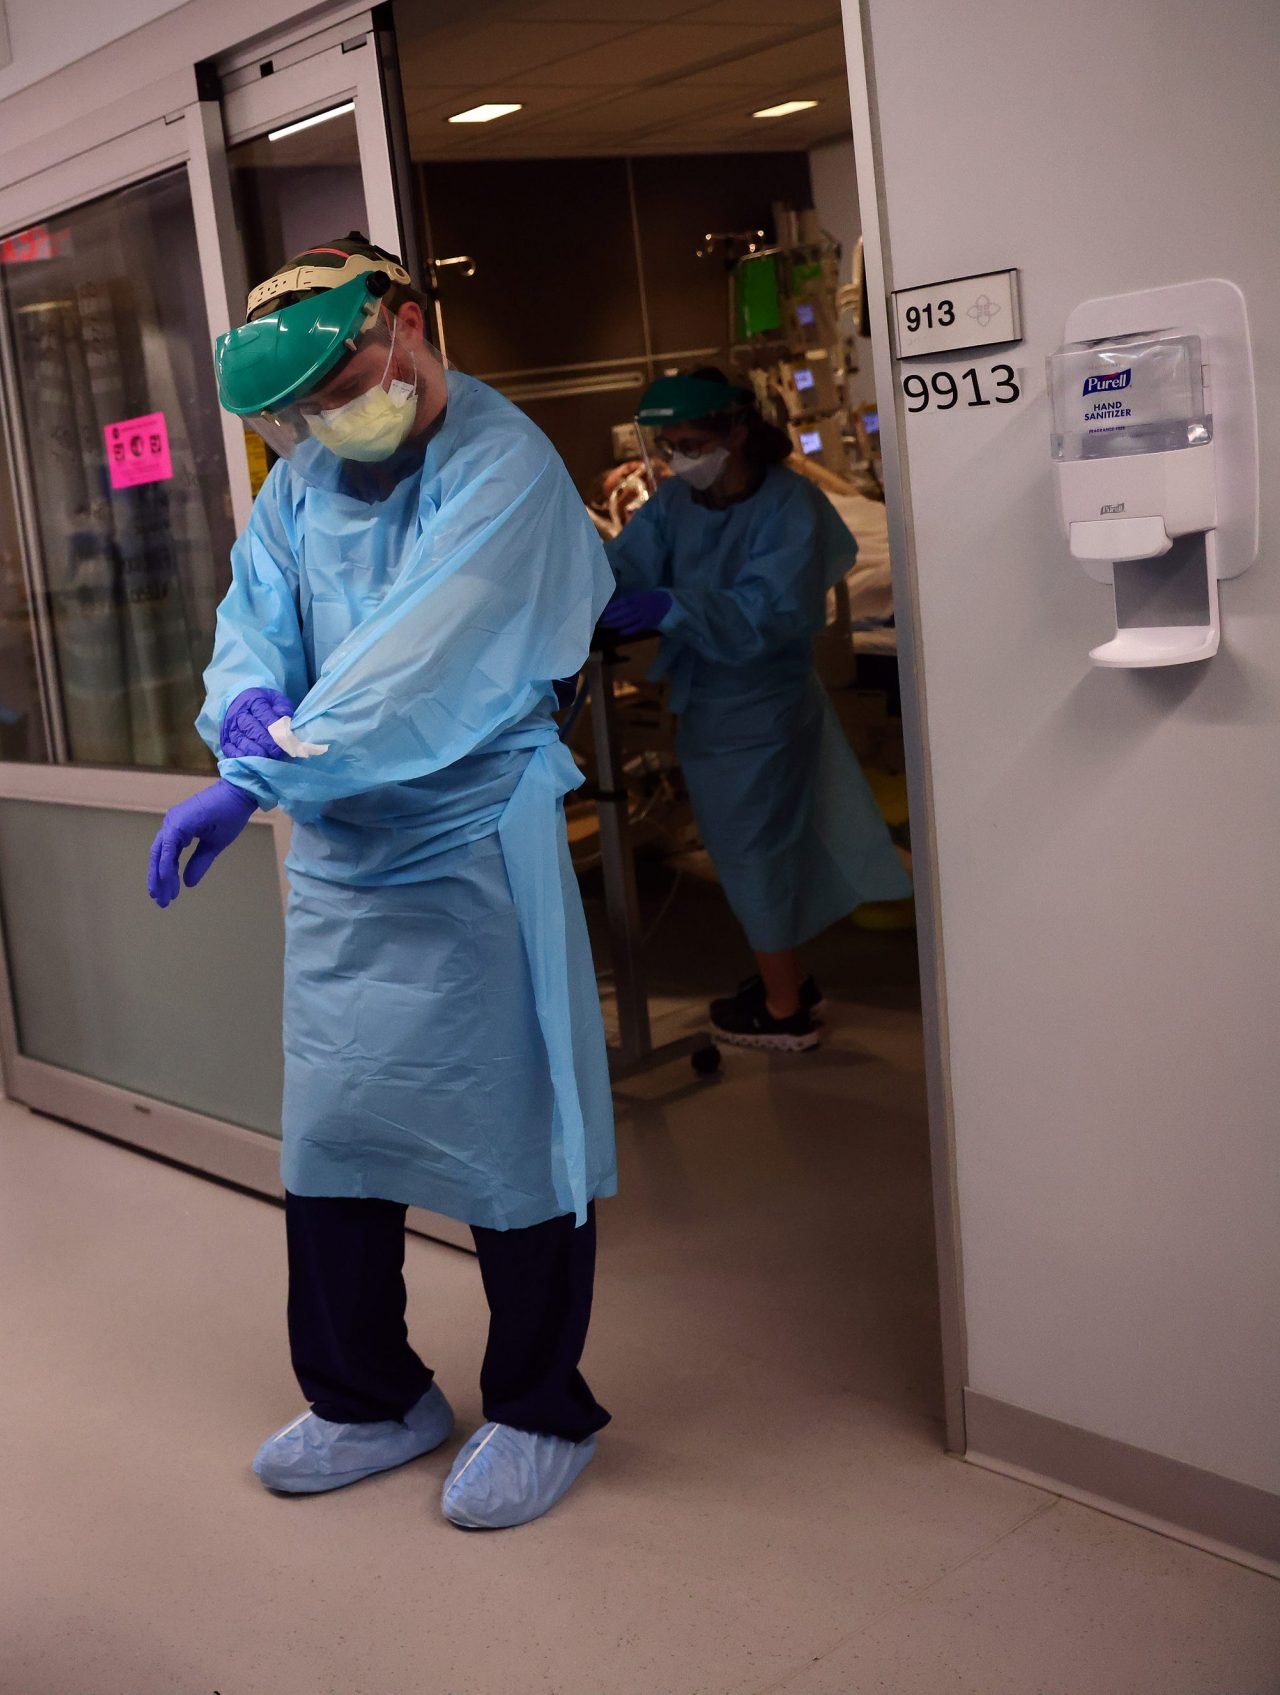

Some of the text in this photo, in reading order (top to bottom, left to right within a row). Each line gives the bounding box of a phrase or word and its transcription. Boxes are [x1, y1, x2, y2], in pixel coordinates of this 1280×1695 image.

[906, 300, 955, 332] 913
[903, 364, 1020, 413] 9913
[1088, 374, 1127, 391] Purell
[1084, 408, 1131, 421] SANITIZER
[1093, 401, 1122, 412] HAND
